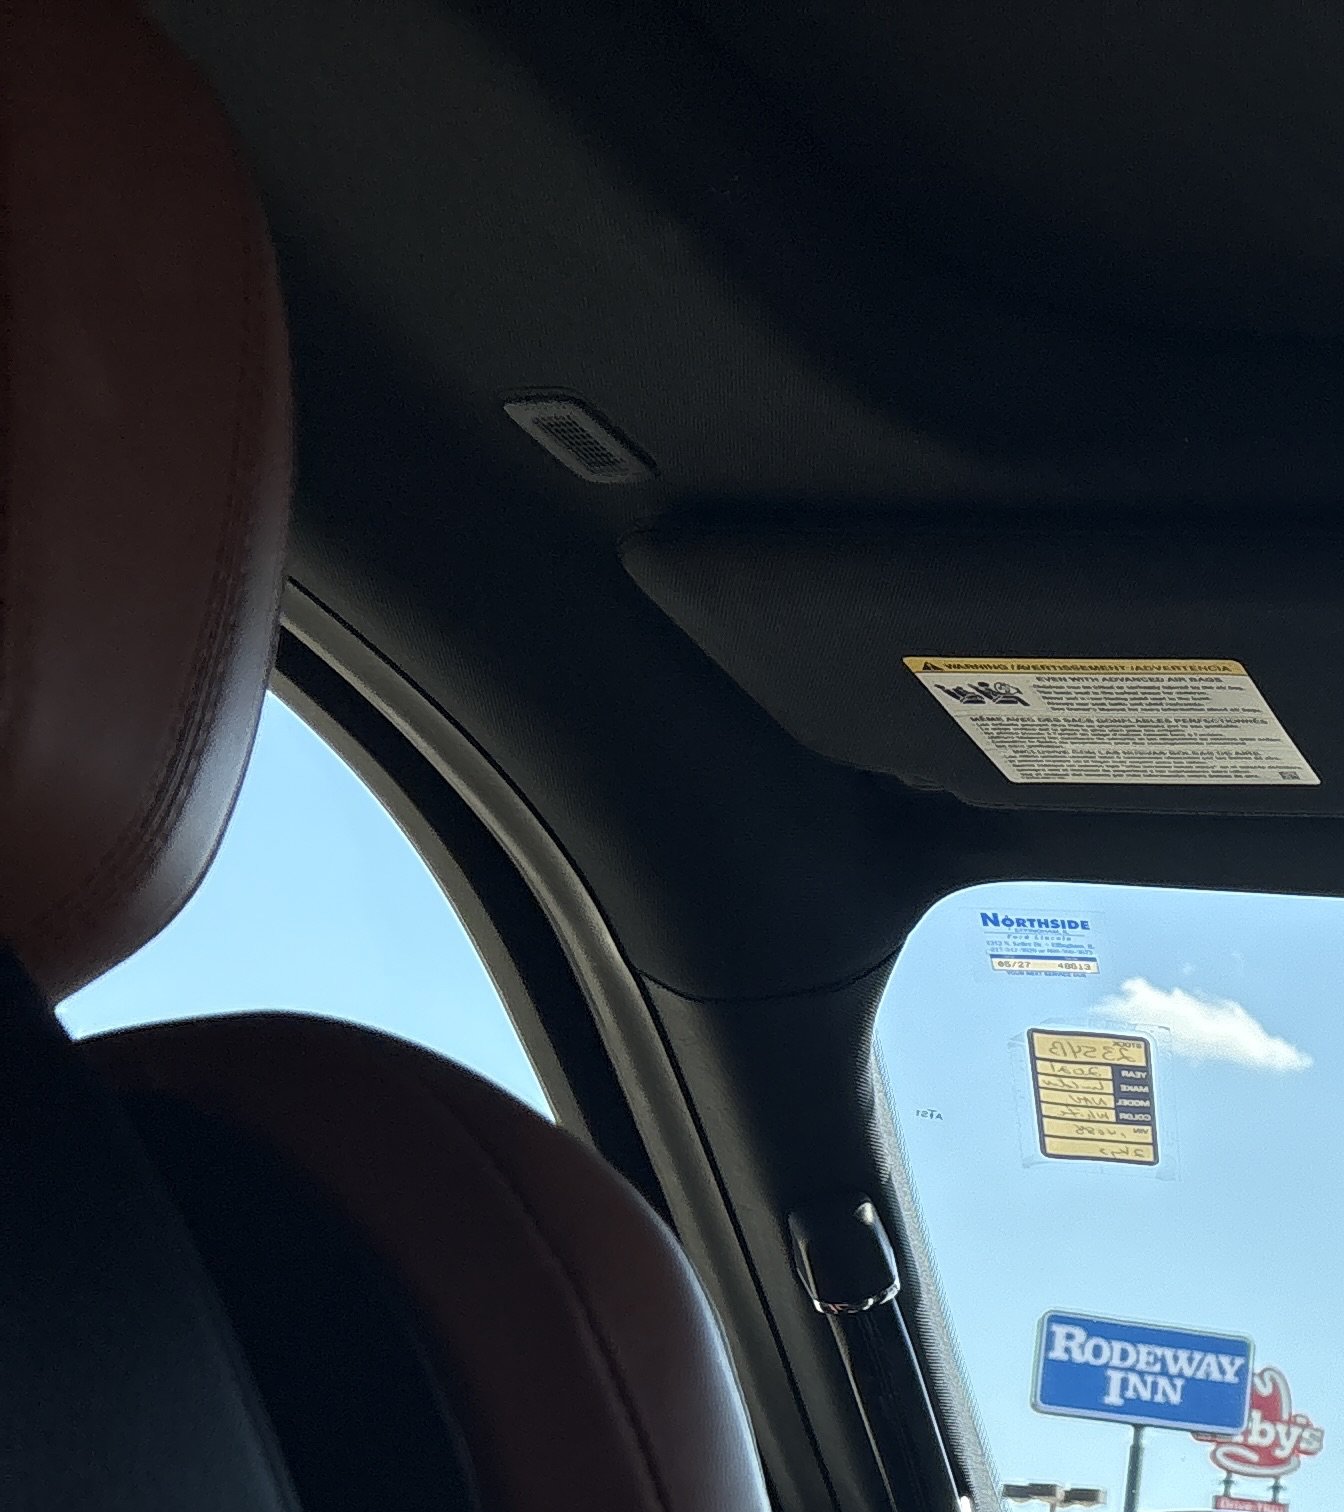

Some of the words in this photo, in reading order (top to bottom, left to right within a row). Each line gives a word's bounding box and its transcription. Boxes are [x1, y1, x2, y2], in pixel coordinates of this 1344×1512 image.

[980, 912, 1090, 930] NORTHSIDE
[1048, 1323, 1245, 1384] RODEWAY
[1103, 1369, 1186, 1406] INN
[1234, 1408, 1323, 1457] by's
